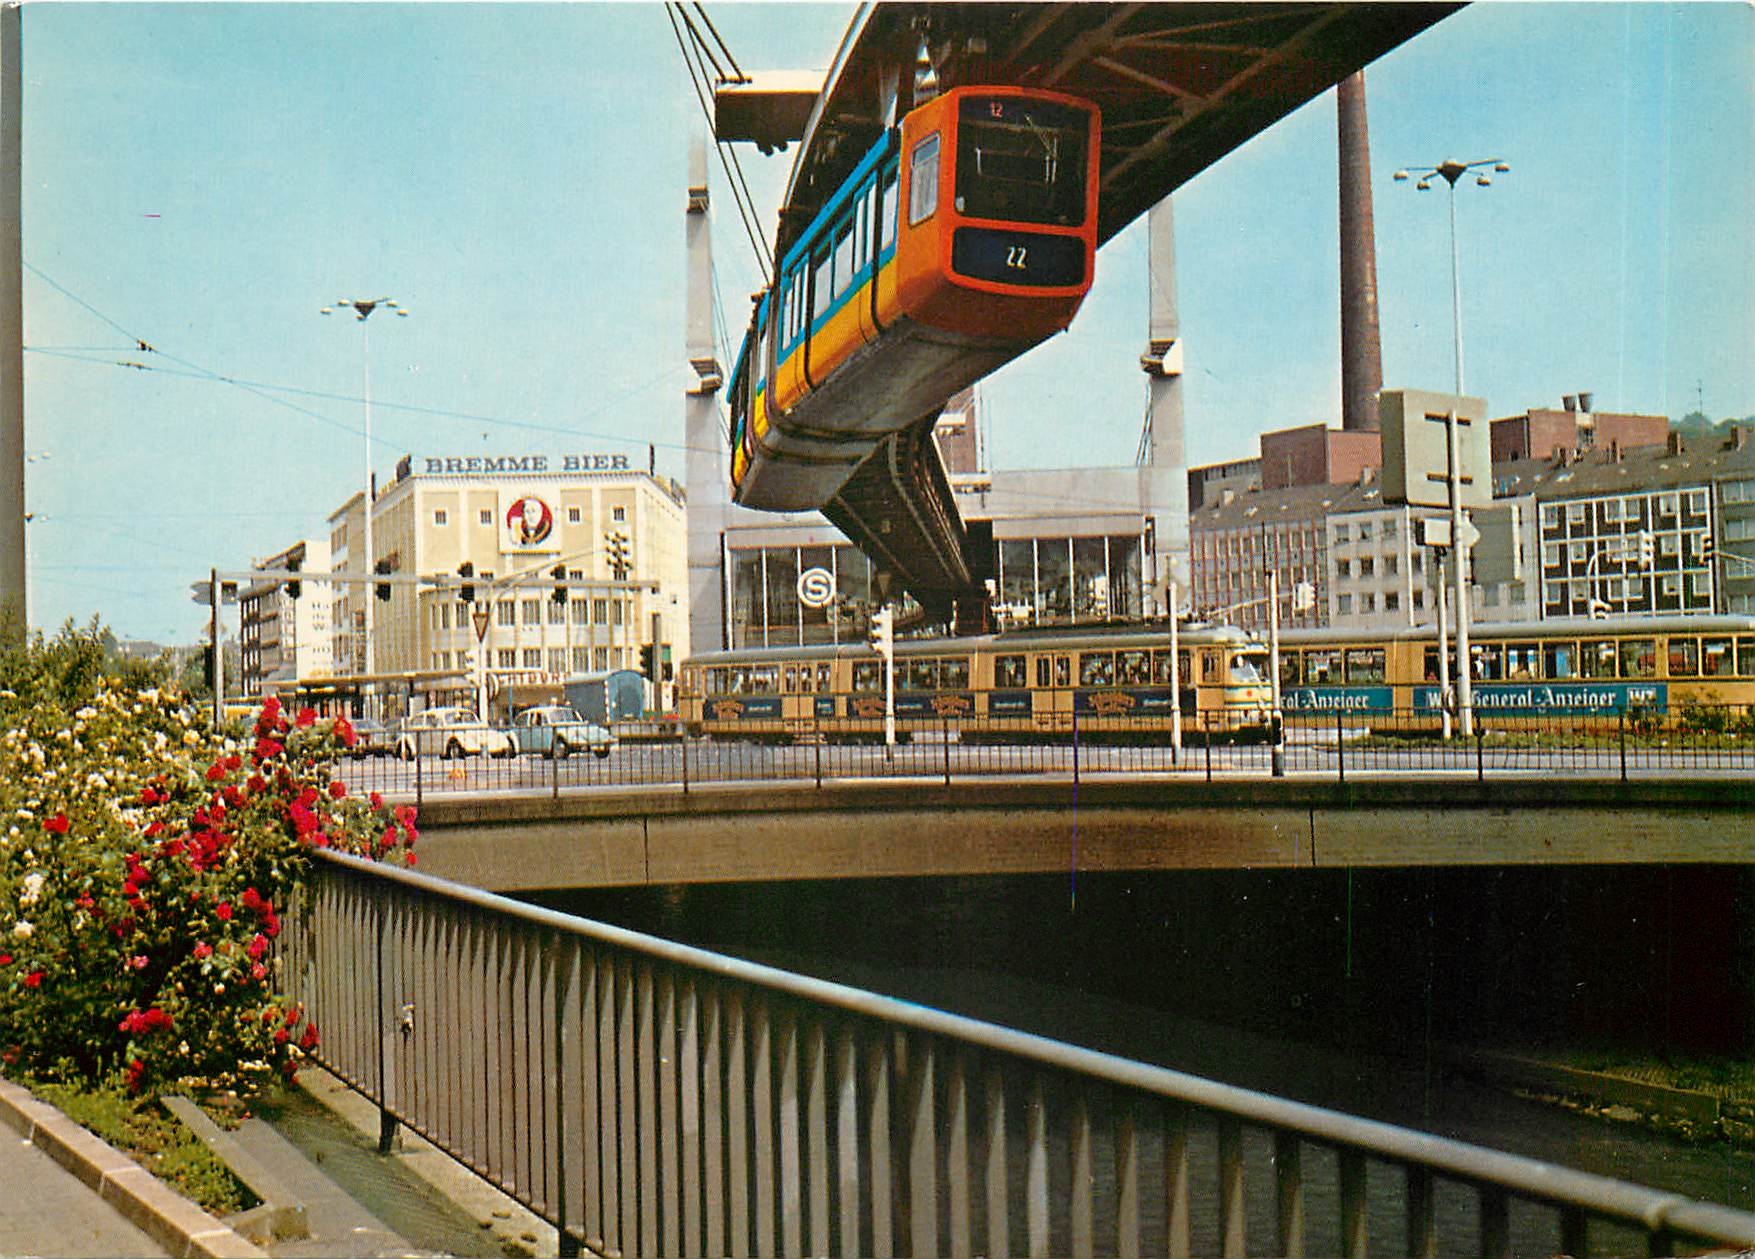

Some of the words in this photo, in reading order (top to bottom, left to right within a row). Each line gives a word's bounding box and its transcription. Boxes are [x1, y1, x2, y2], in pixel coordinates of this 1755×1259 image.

[1006, 246, 1027, 270] 22
[425, 456, 548, 474] BREMME
[563, 455, 630, 472] BIER
[1280, 689, 1369, 712] ral-Anzeiger
